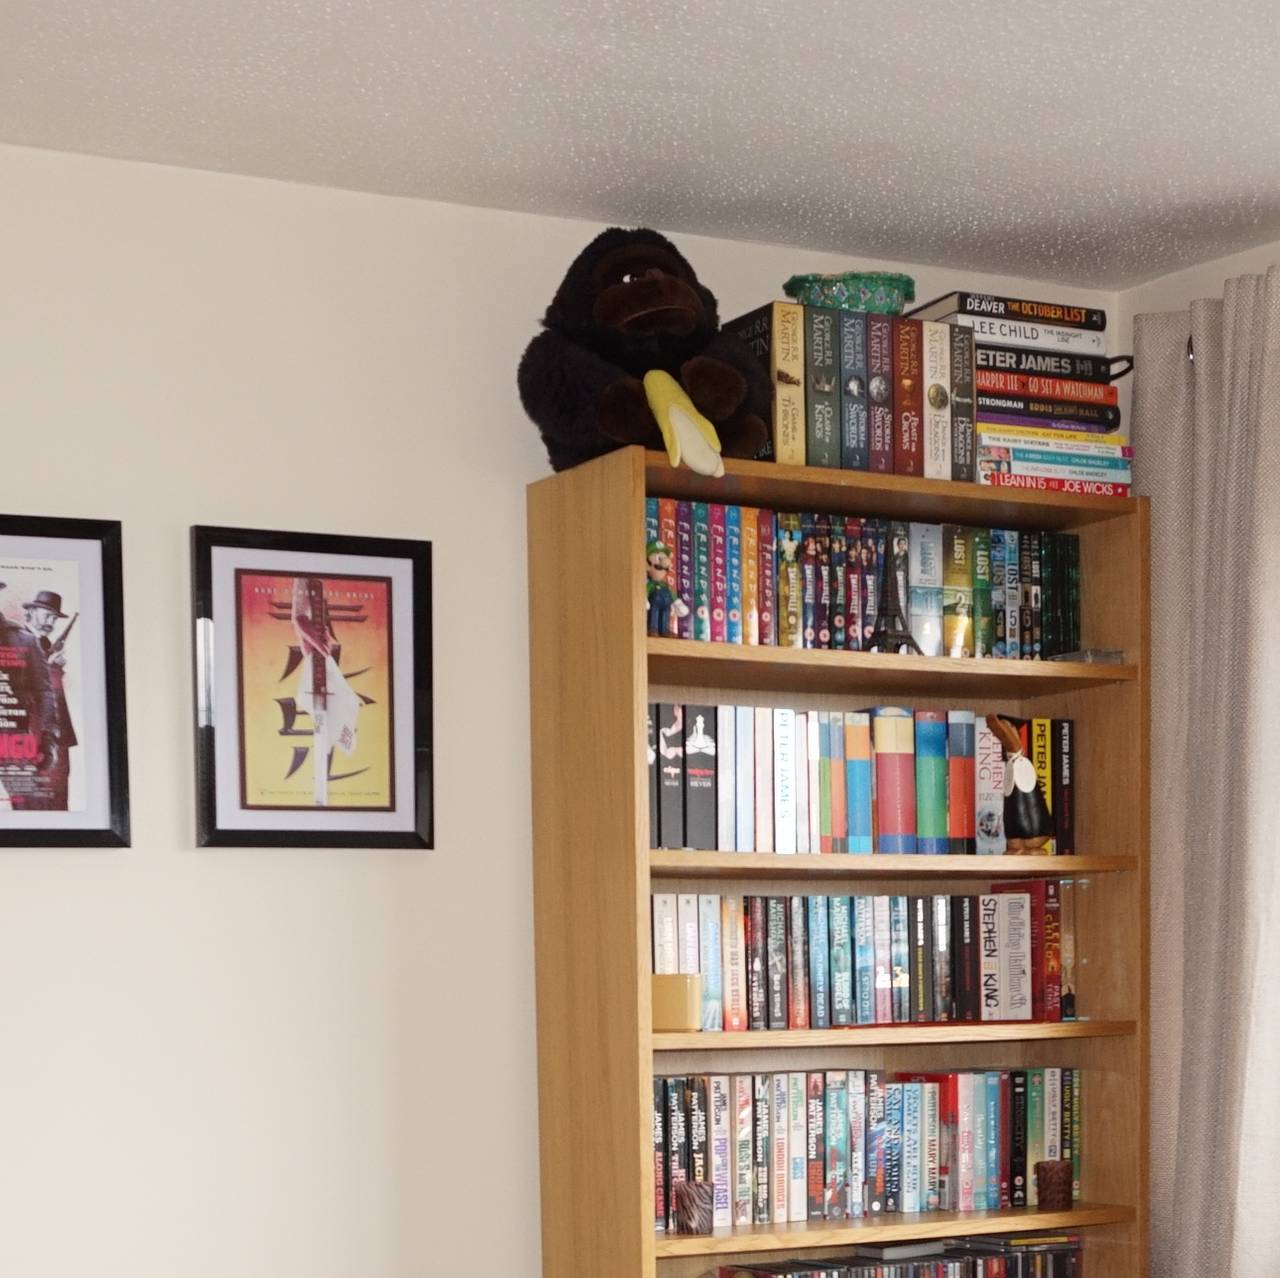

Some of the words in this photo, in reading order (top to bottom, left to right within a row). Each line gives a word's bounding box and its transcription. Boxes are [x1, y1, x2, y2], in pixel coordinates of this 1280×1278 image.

[967, 299, 1005, 313] DEAVER
[1008, 302, 1020, 312] THE
[1022, 302, 1063, 319] OCTOBER
[1064, 308, 1086, 322] LIST
[781, 310, 790, 362] MARTIN
[813, 314, 824, 366] MARTIN
[844, 318, 854, 369] MARTIN
[871, 321, 881, 373] MARTIN
[972, 320, 996, 334] LEE
[1000, 322, 1039, 340] CHILD
[900, 326, 910, 375] MARTIN
[929, 329, 938, 379] MARTIN
[954, 333, 963, 383] MARTIN
[1020, 354, 1071, 373] JAMES
[978, 397, 1024, 409] STRONGMAN
[1008, 375, 1018, 391] LEE
[1028, 378, 1038, 392] GO
[1042, 379, 1053, 393] SET
[1055, 382, 1061, 394] A
[1063, 381, 1104, 401] WATCHMAN
[782, 397, 791, 446] THRONES
[815, 404, 824, 440] KINGS
[849, 403, 858, 448] SWORDS
[875, 407, 884, 451] SWORDS
[902, 412, 911, 450] CROWS
[957, 417, 966, 464] DRAGONS
[1000, 475, 1025, 488] LEAN
[1027, 476, 1036, 488] IN
[1038, 476, 1046, 489] 15
[1062, 480, 1081, 492] JOE
[1083, 481, 1113, 496] WICKS
[954, 540, 965, 564] LOST
[977, 551, 988, 581] LOST
[1032, 561, 1040, 577] LOST
[788, 568, 796, 611] SMALLVILLE
[805, 565, 813, 603] SMALLVILLE
[821, 566, 829, 604] SMALLVILLE
[836, 567, 844, 604] SMALLVILLE
[850, 574, 858, 613] SMALLVILLE
[866, 575, 874, 614] SMALLVILLE
[1008, 563, 1017, 591] LOST
[779, 712, 789, 762] PETER
[979, 732, 991, 780] KING
[1037, 723, 1047, 770] PETER
[780, 768, 790, 818] JAMES
[832, 898, 841, 952] MARSHALL
[857, 899, 865, 945] PATTERSON
[982, 898, 997, 958] STEPHEN
[1045, 914, 1053, 959] CHILD
[773, 974, 781, 990] BAD
[834, 972, 842, 1009] ANGELS
[983, 973, 999, 1007] KING
[843, 999, 849, 1009] OF
[714, 1081, 722, 1125] PATTERSON
[830, 1093, 838, 1145] PATTERSON
[869, 1074, 877, 1129] PATTERSON
[876, 1088, 884, 1118] JAMES
[892, 1088, 900, 1112] CAT
[905, 1089, 913, 1117] JAMES
[654, 1110, 663, 1143] JAMES
[671, 1094, 679, 1150] PATTERSON
[691, 1093, 699, 1149] PATTERSON
[698, 1110, 706, 1142] JAMES
[808, 1099, 816, 1159] PATTERSON
[837, 1109, 845, 1138] JAMES
[892, 1120, 900, 1146] AND
[1063, 1112, 1071, 1141] BETTY
[715, 1138, 727, 1155] POP
[775, 1138, 785, 1171] LONDON
[655, 1151, 663, 1186] ALONG
[792, 1157, 804, 1180] CROSS
[928, 1168, 936, 1192] MARY
[656, 1188, 664, 1216] CAME
[715, 1172, 728, 1211] WEASEL
[776, 1173, 785, 1209] BRIDGES
